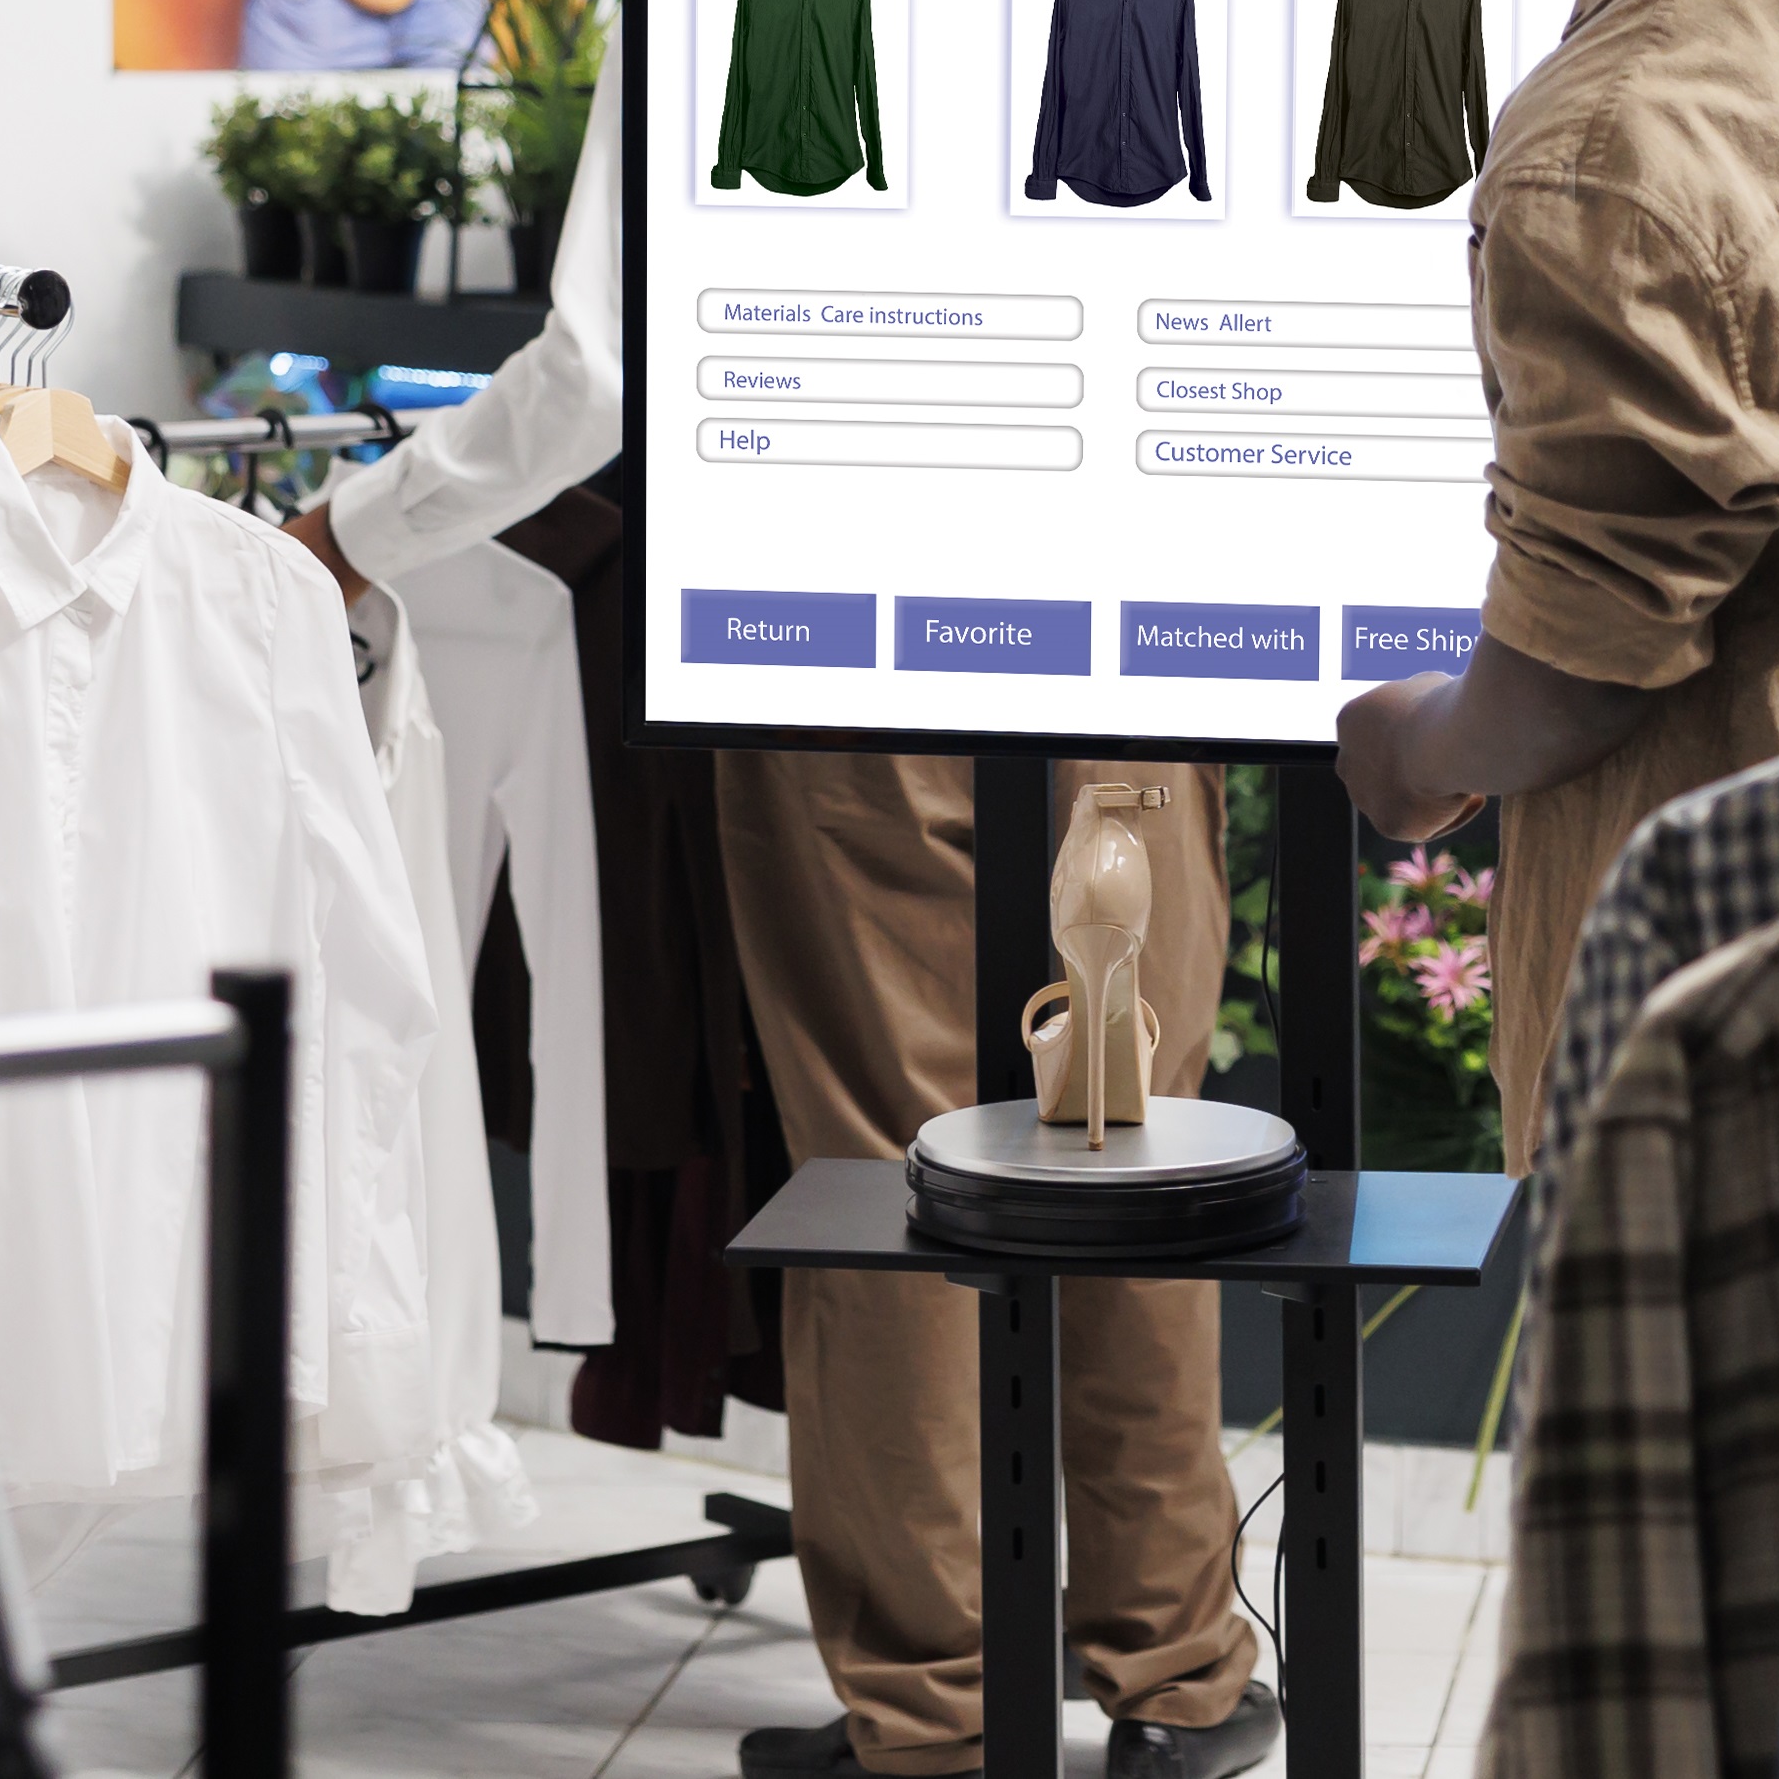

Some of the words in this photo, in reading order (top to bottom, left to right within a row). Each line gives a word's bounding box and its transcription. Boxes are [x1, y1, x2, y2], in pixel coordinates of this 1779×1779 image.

[725, 304, 810, 322] Materials
[821, 306, 863, 323] Care
[870, 307, 982, 325] instructions
[1157, 313, 1208, 330] News
[1219, 314, 1271, 332] Allert
[725, 371, 801, 389] Reviews
[1157, 381, 1226, 399] Closest
[1232, 382, 1282, 404] Shop
[721, 430, 770, 455] Help
[1156, 442, 1264, 463] Customer
[1271, 444, 1351, 465] Service
[728, 618, 809, 641] Return
[927, 620, 1032, 645] Favorite
[1138, 625, 1243, 648] Matched
[1252, 629, 1304, 650] with
[1356, 627, 1408, 650] Free
[1416, 628, 1478, 658] Ship
